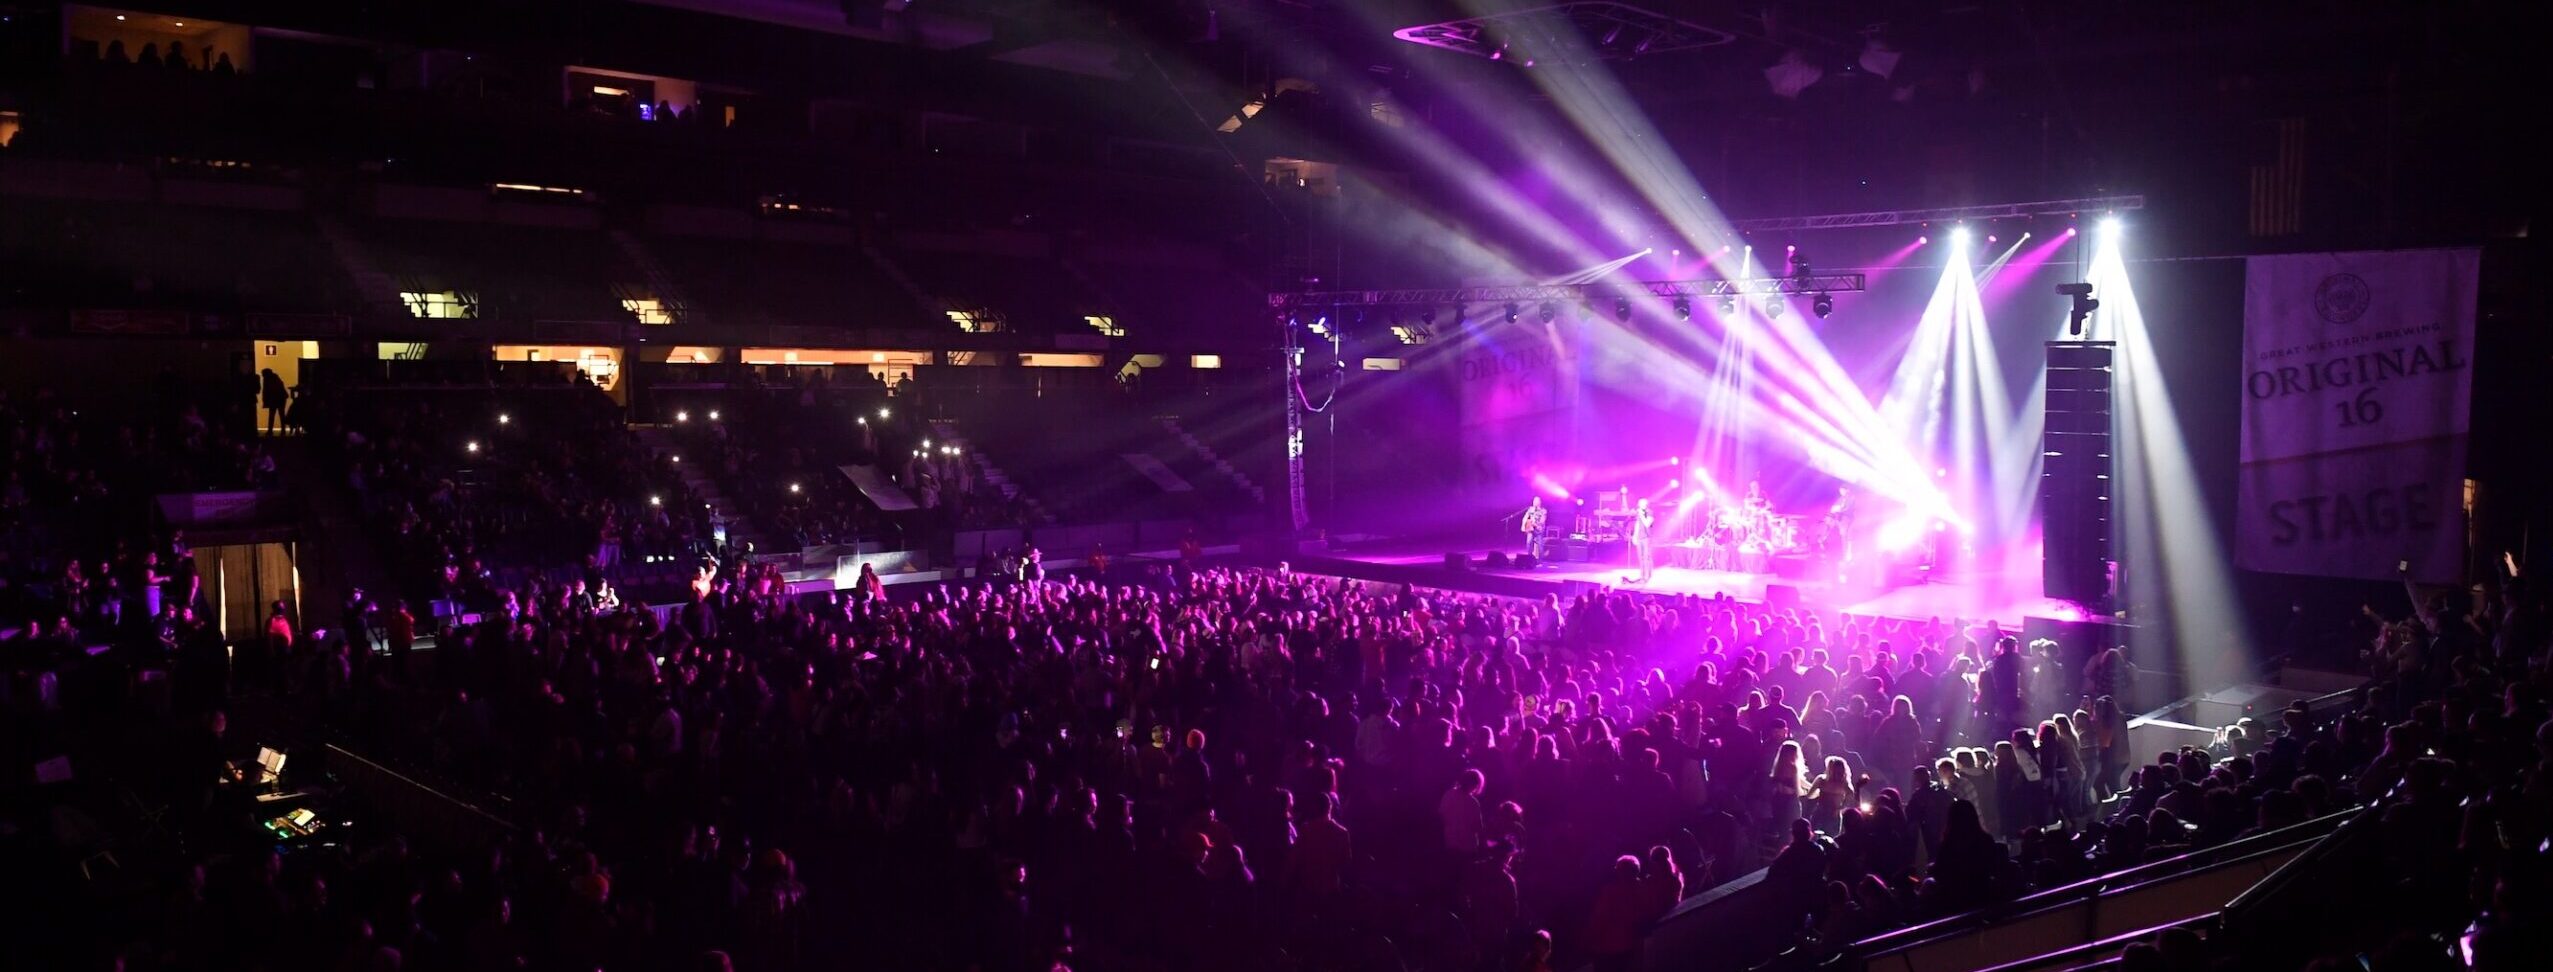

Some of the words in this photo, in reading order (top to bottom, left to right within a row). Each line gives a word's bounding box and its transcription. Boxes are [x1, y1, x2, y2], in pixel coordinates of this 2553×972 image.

[2260, 346, 2300, 360] GREAT
[2306, 336, 2369, 351] WESTERN
[2376, 322, 2441, 341] BREWING
[2248, 340, 2466, 399] ORIGINAL
[2336, 387, 2382, 428] 16
[2268, 482, 2437, 545] STAGE
